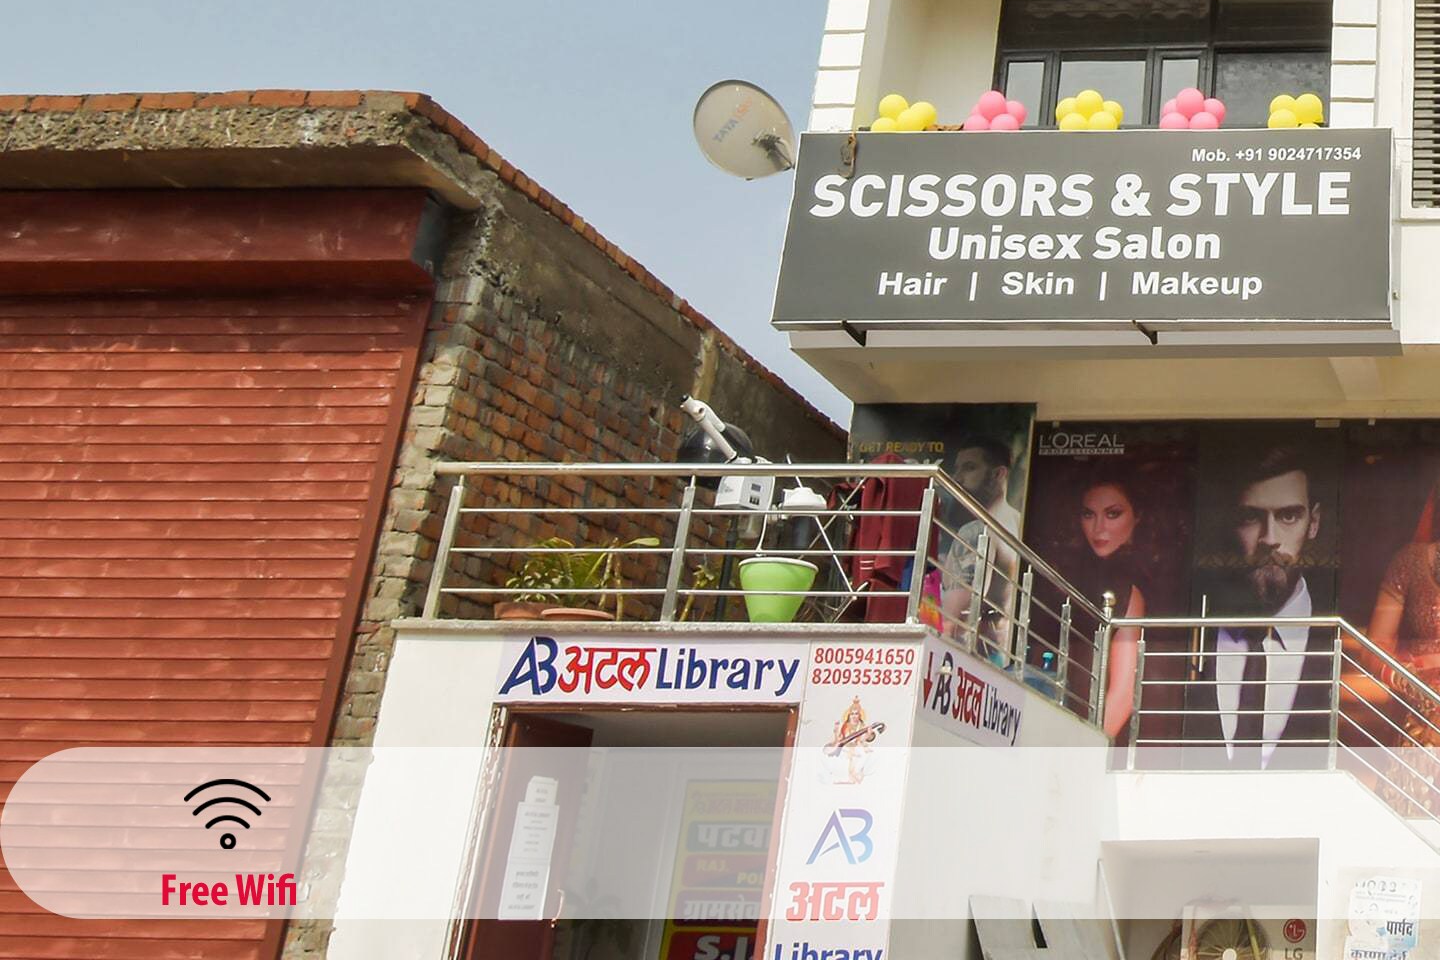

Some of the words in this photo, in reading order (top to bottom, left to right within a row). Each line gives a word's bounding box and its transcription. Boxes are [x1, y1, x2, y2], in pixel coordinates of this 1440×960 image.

[1190, 148, 1230, 162] Mob.
[1235, 148, 1263, 161] +91
[1268, 147, 1362, 161] 9024717354
[809, 174, 1094, 218] SCISSORS
[1110, 173, 1152, 217] &
[1166, 172, 1351, 216] STYLE
[928, 225, 1083, 260] Unisex
[1092, 226, 1221, 259] Salon
[878, 272, 948, 296] Hair
[1001, 271, 1075, 296] Skin
[1132, 271, 1263, 300] Makeup
[499, 636, 558, 696] AB
[557, 646, 657, 694] अटल
[655, 648, 800, 697] Library
[814, 647, 915, 666] 8005941650
[811, 668, 913, 685] 8209353837
[952, 666, 986, 730] अटल
[983, 683, 1022, 747] Library
[805, 808, 874, 865] AB
[785, 881, 886, 922] अटल
